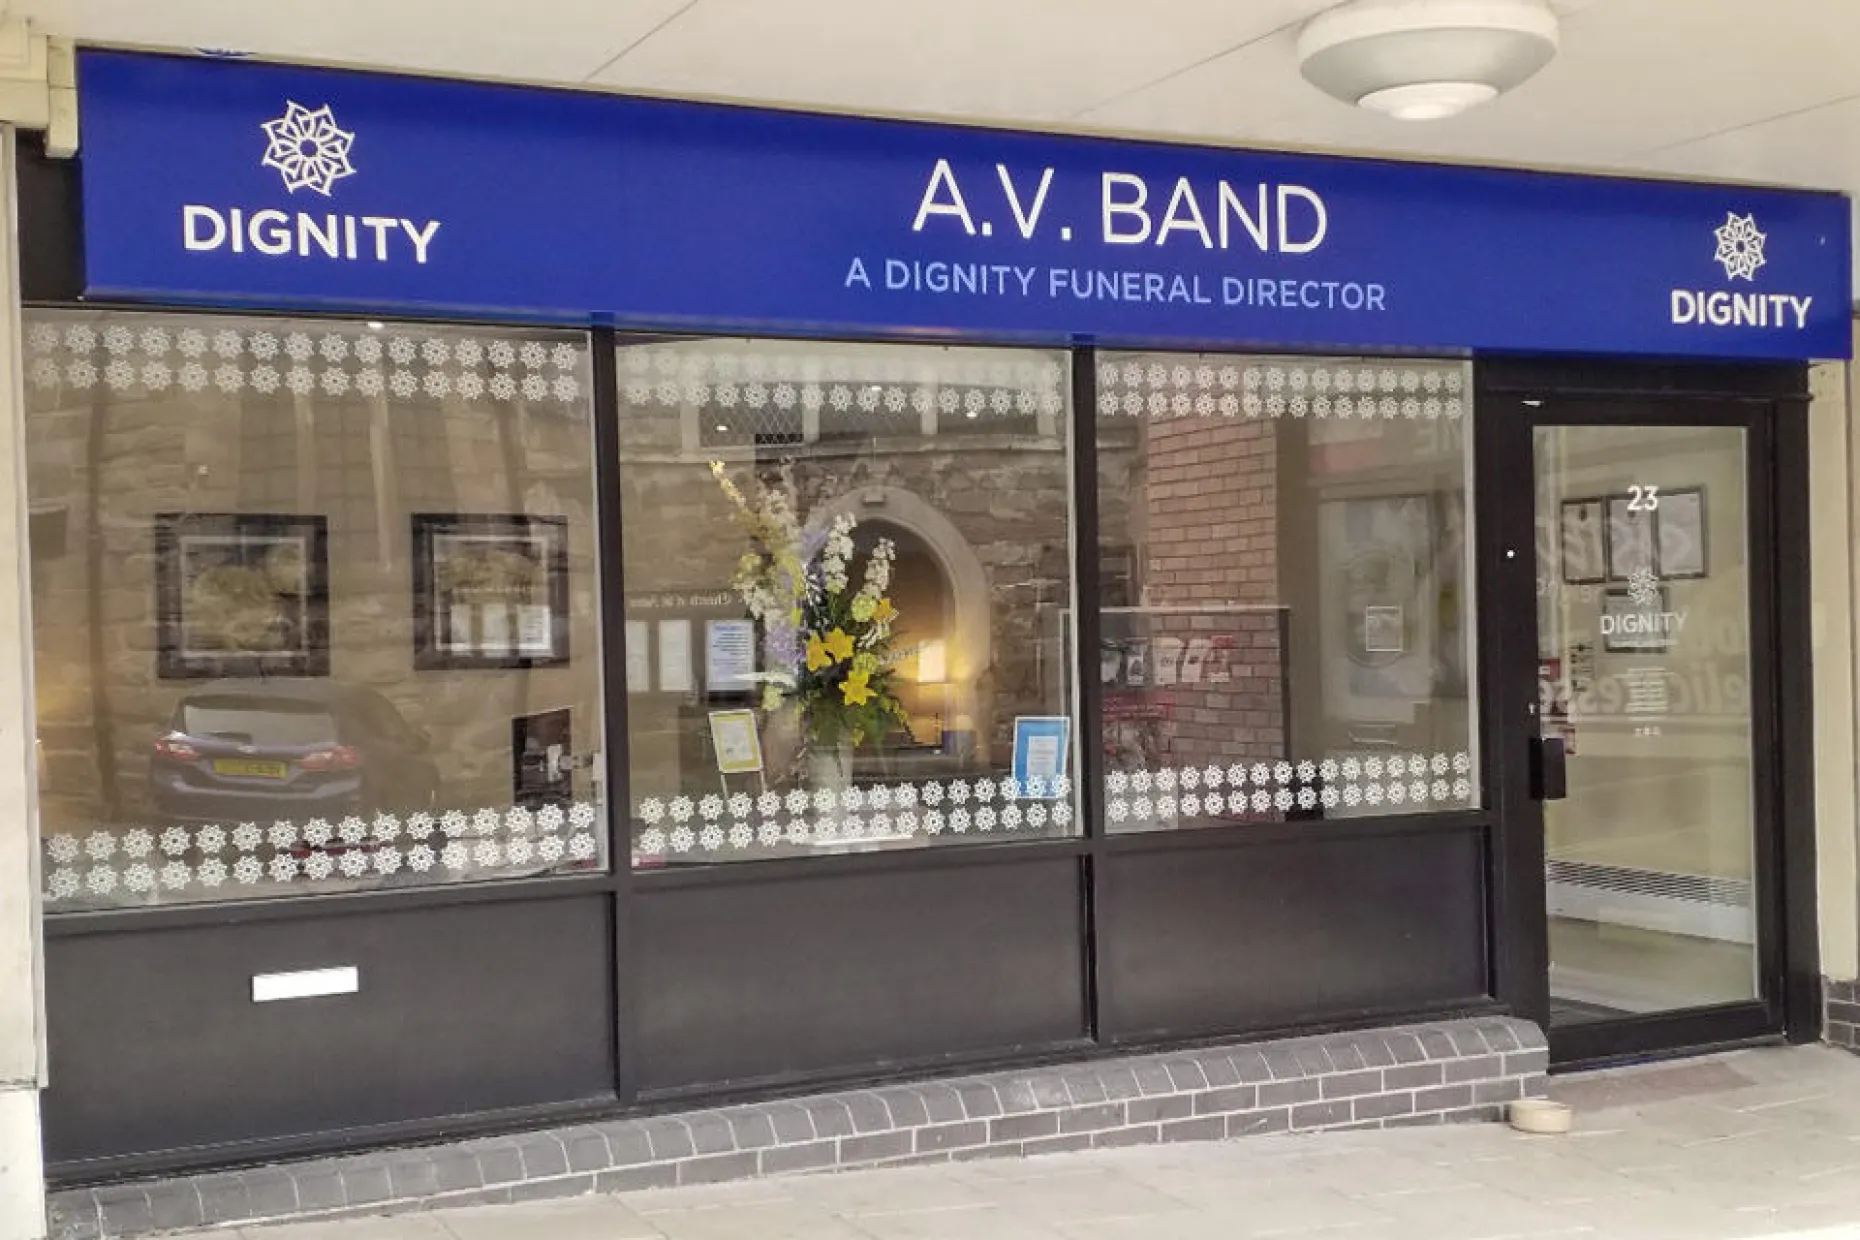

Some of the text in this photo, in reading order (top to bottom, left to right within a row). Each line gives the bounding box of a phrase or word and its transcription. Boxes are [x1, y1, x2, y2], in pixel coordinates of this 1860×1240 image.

[912, 158, 1329, 254] A.V. BAND
[183, 204, 441, 265] DIGNITY
[844, 257, 1386, 312] A DIGNITY FUNERAL DIRECTOR
[1671, 289, 1812, 329] DIGNITY
[1626, 485, 1659, 511] 23
[1600, 605, 1687, 635] DIGNITY
